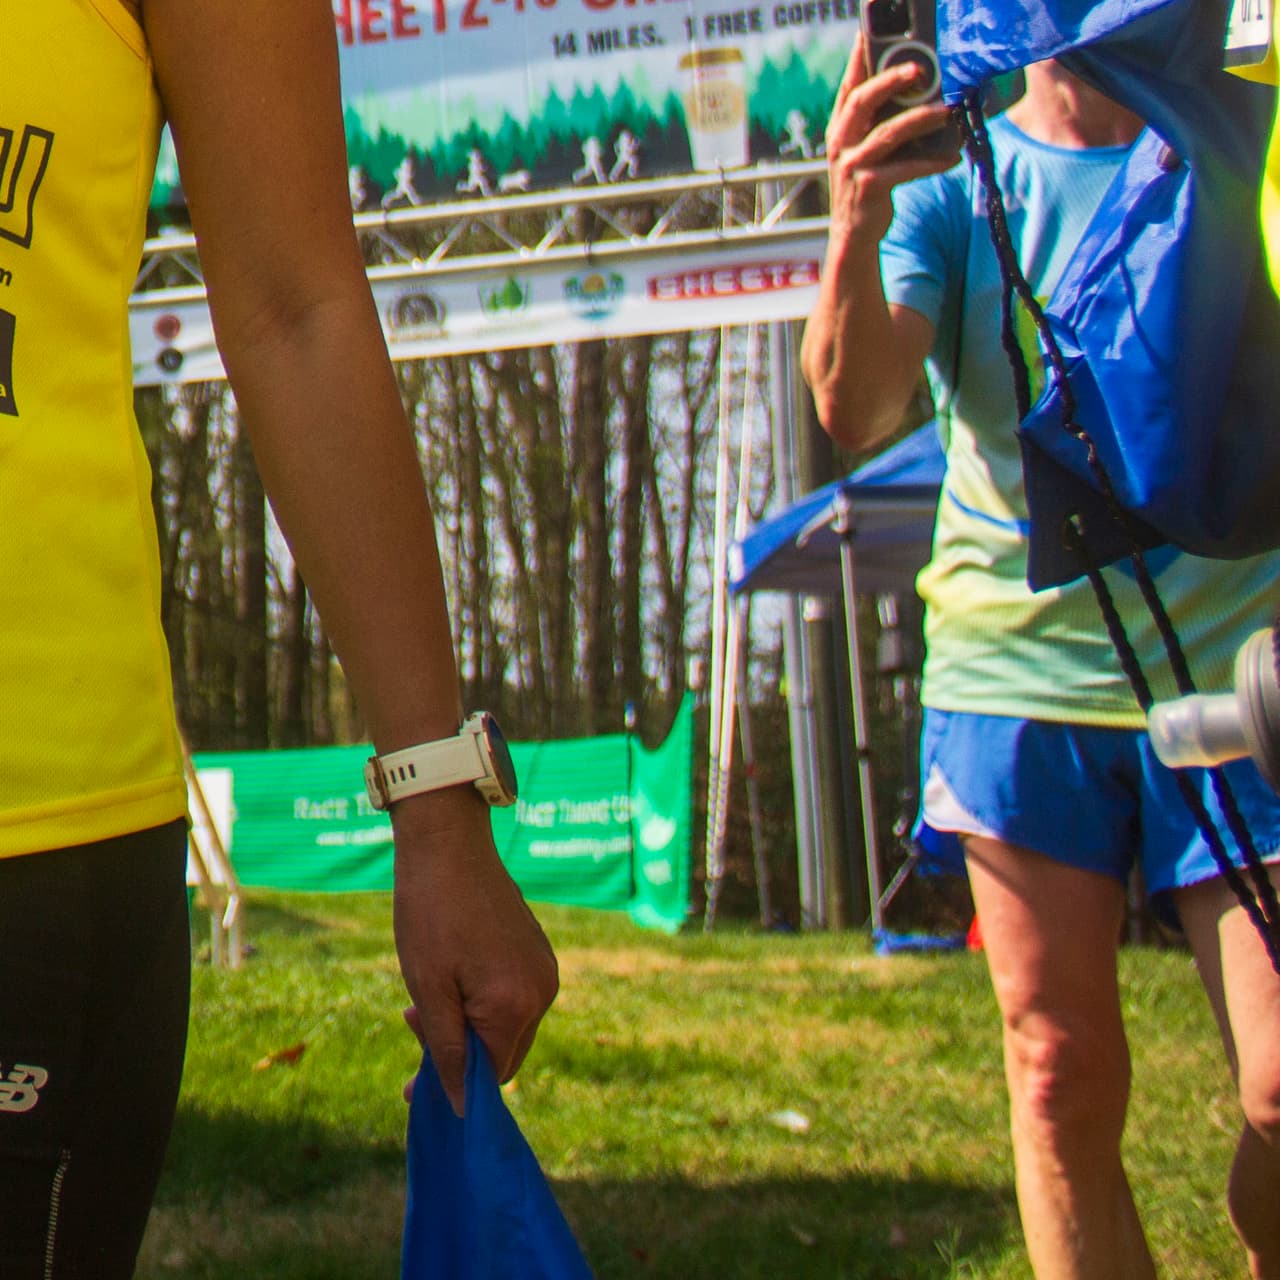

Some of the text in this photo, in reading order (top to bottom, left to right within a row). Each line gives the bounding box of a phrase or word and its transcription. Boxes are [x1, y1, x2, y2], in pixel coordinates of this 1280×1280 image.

[551, 31, 577, 59] 14
[704, 6, 764, 40] FREE
[655, 263, 810, 298] SHEETZ
